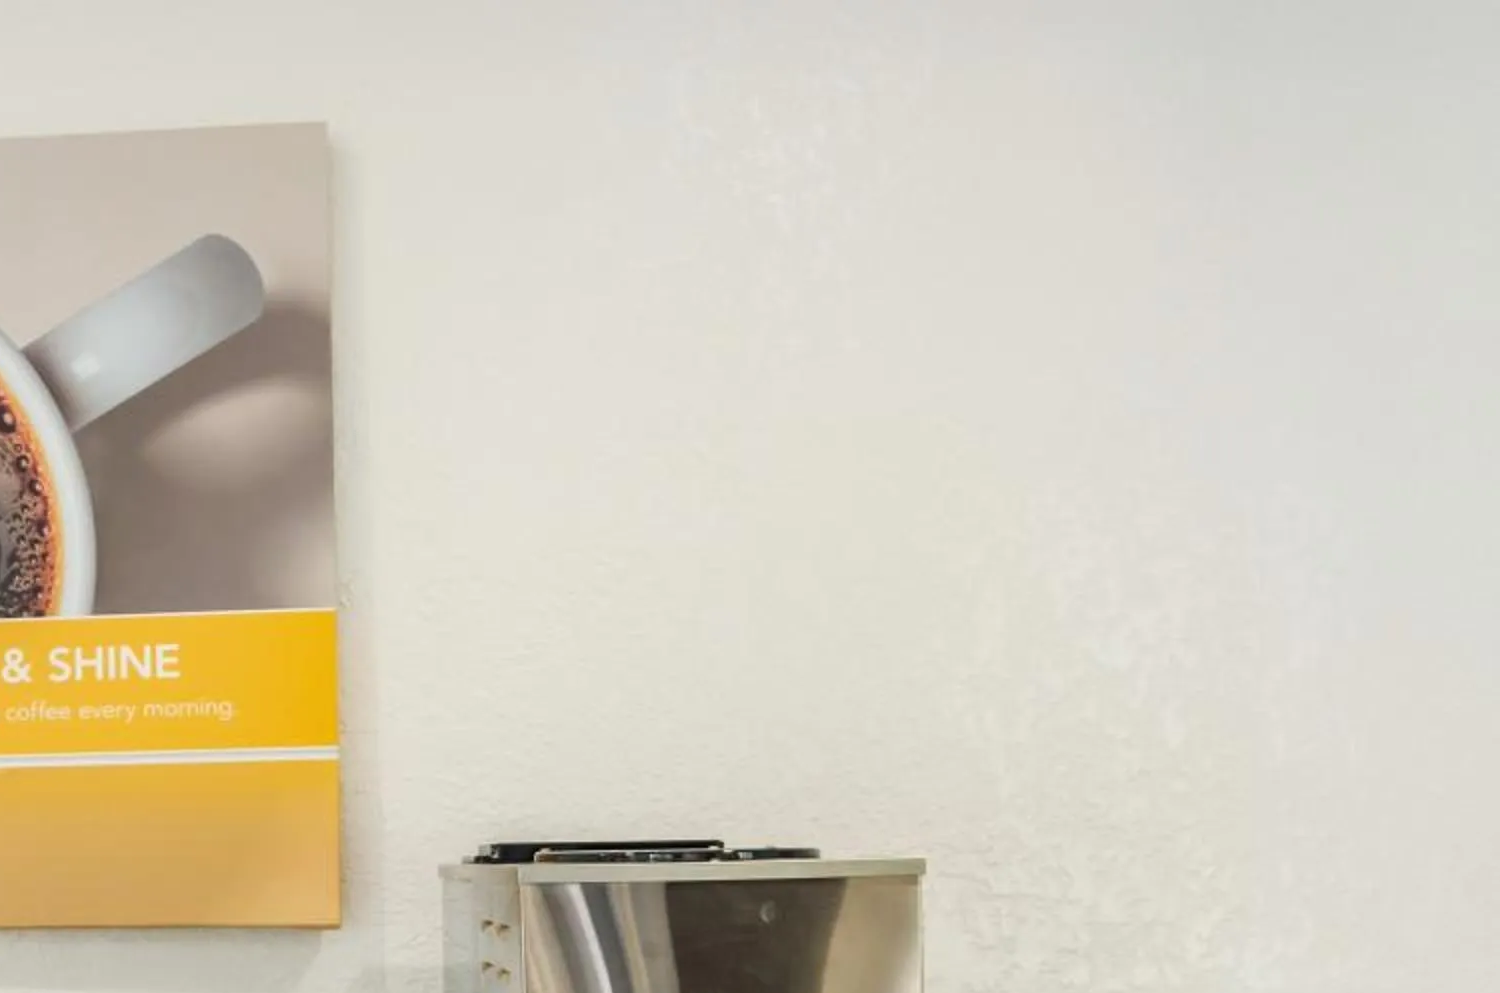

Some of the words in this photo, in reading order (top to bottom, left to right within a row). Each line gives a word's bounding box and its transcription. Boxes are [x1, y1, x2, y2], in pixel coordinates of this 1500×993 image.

[1, 647, 32, 684] &
[48, 643, 181, 682] SHINE
[5, 700, 71, 722] coffee
[79, 705, 135, 724] every
